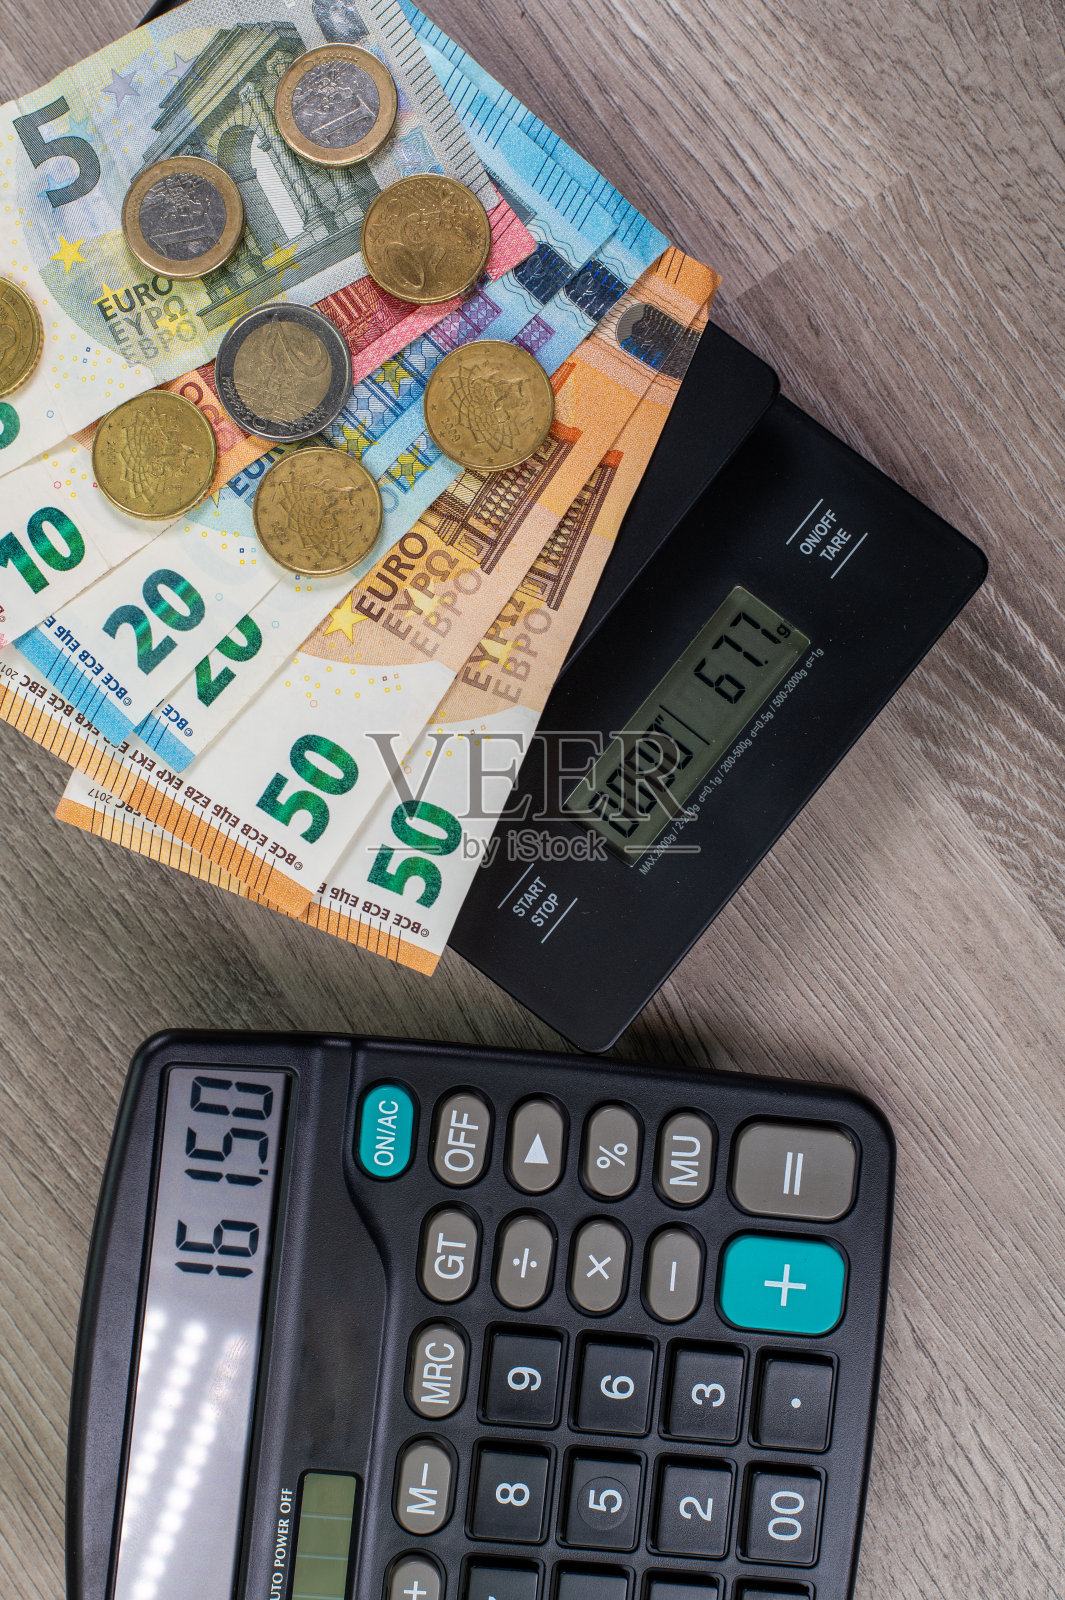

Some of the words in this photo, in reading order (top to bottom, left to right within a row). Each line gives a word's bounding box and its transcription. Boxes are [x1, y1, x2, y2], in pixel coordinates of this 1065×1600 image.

[12, 95, 101, 208] 5
[96, 274, 173, 322] EURO
[800, 509, 837, 555] ON/OFF
[819, 528, 852, 561] TARE
[0, 506, 86, 594] 10
[354, 532, 428, 622] EURO
[102, 568, 206, 676] 20
[0, 661, 19, 681] 201
[78, 649, 104, 676] ECB
[19, 674, 48, 699] EBC
[698, 774, 723, 804] d=0.1g
[720, 737, 753, 772] 200-500g
[750, 709, 775, 738] d=0.5g
[772, 667, 808, 708] 500-2000g
[805, 647, 824, 669] d=1g
[128, 749, 157, 772] EKT
[88, 788, 113, 804] 2017
[155, 768, 185, 791] EKP
[256, 734, 359, 845] 50
[184, 786, 212, 809] EZB
[240, 823, 269, 847] ECB
[366, 799, 463, 909] 50
[361, 900, 391, 921] ECB
[512, 876, 547, 917] START
[530, 893, 559, 927] STOP
[373, 1099, 399, 1167] ON/AC
[444, 1109, 480, 1173] OFF
[669, 1134, 701, 1187] MU
[433, 1232, 468, 1280] GT
[420, 1341, 455, 1405] MRC
[507, 1366, 542, 1392] 9
[600, 1374, 635, 1400] 6
[691, 1382, 726, 1408] 3
[280, 1487, 293, 1514] OFF
[495, 1482, 530, 1507] 8
[588, 1488, 623, 1513] 5
[679, 1496, 714, 1522] 2
[767, 1490, 805, 1542] 00
[274, 1518, 290, 1567] POWER
[269, 1571, 284, 1600] UTO
